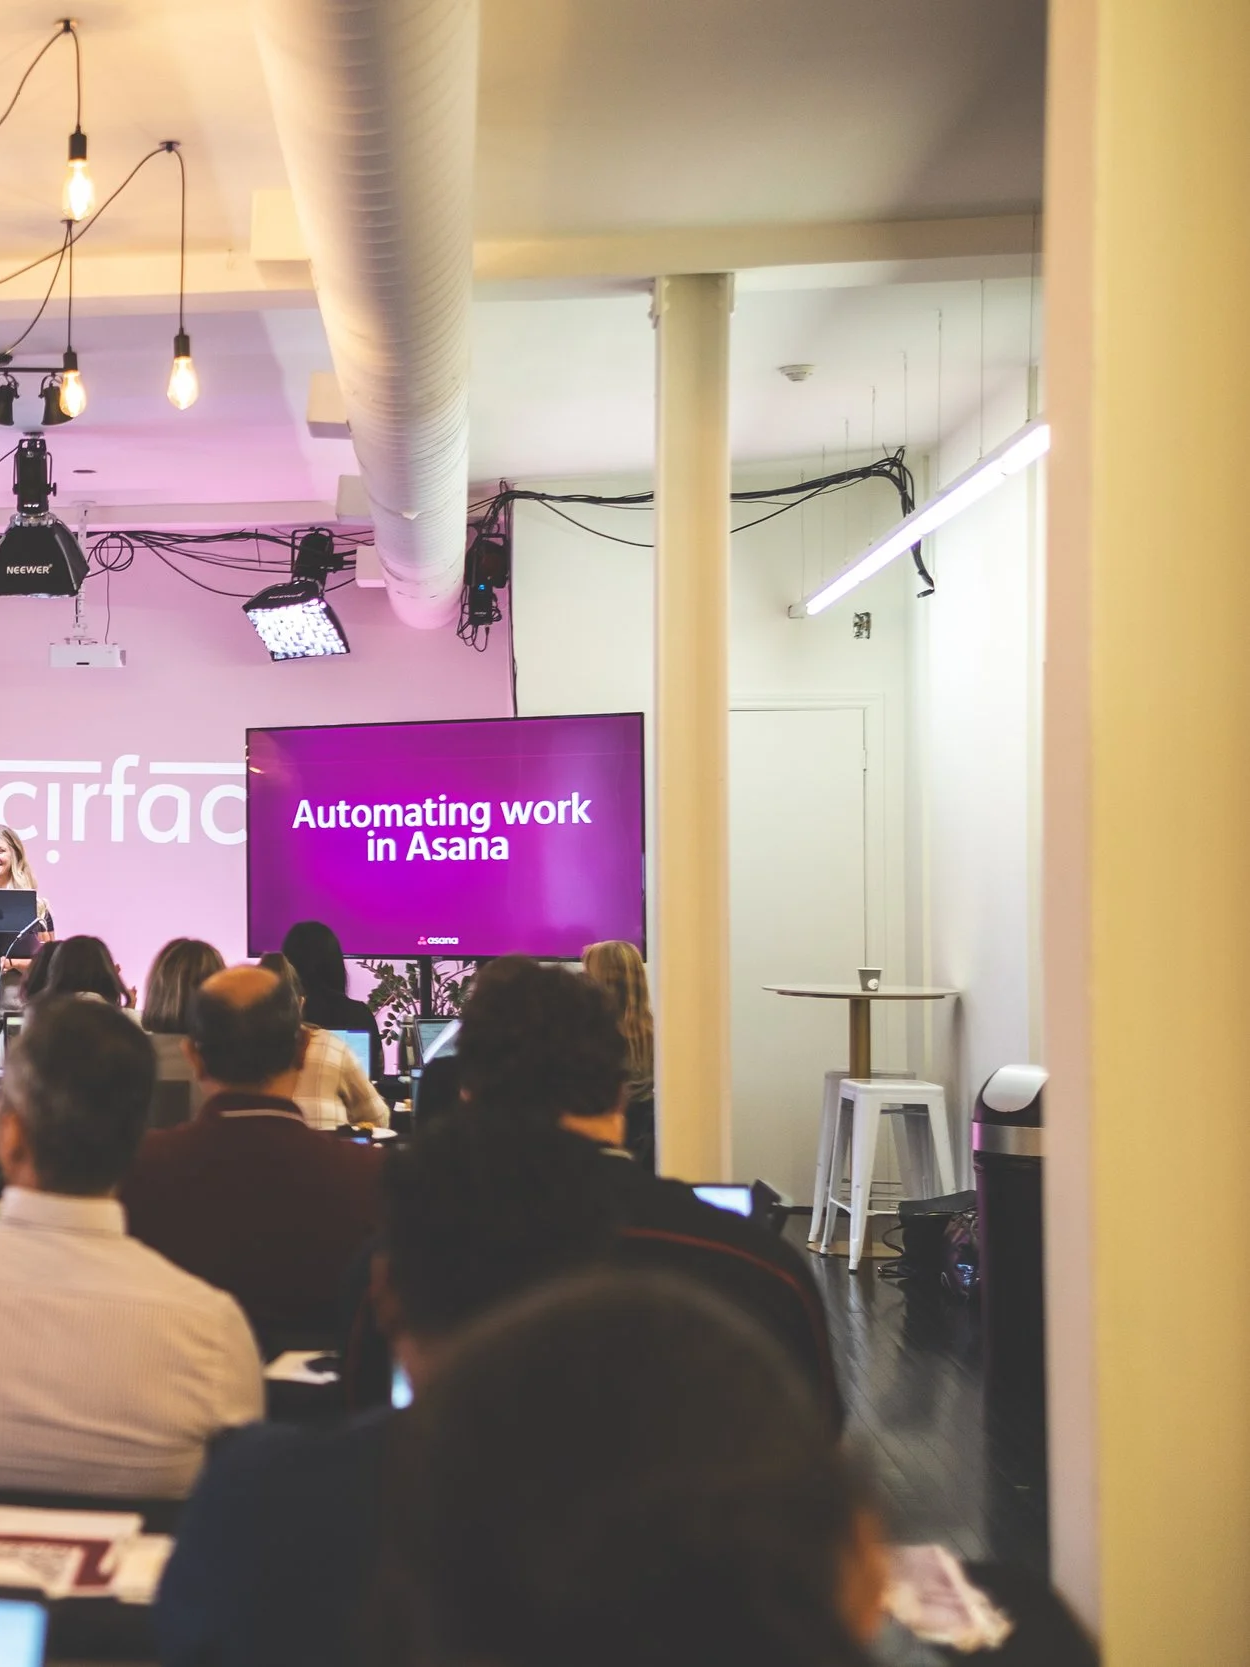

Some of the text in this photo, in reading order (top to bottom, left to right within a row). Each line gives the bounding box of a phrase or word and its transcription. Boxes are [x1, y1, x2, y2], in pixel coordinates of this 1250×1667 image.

[6, 565, 51, 575] NEEWER
[291, 792, 592, 833] Automating work
[367, 830, 510, 862] in Asana
[426, 936, 459, 945] asana
